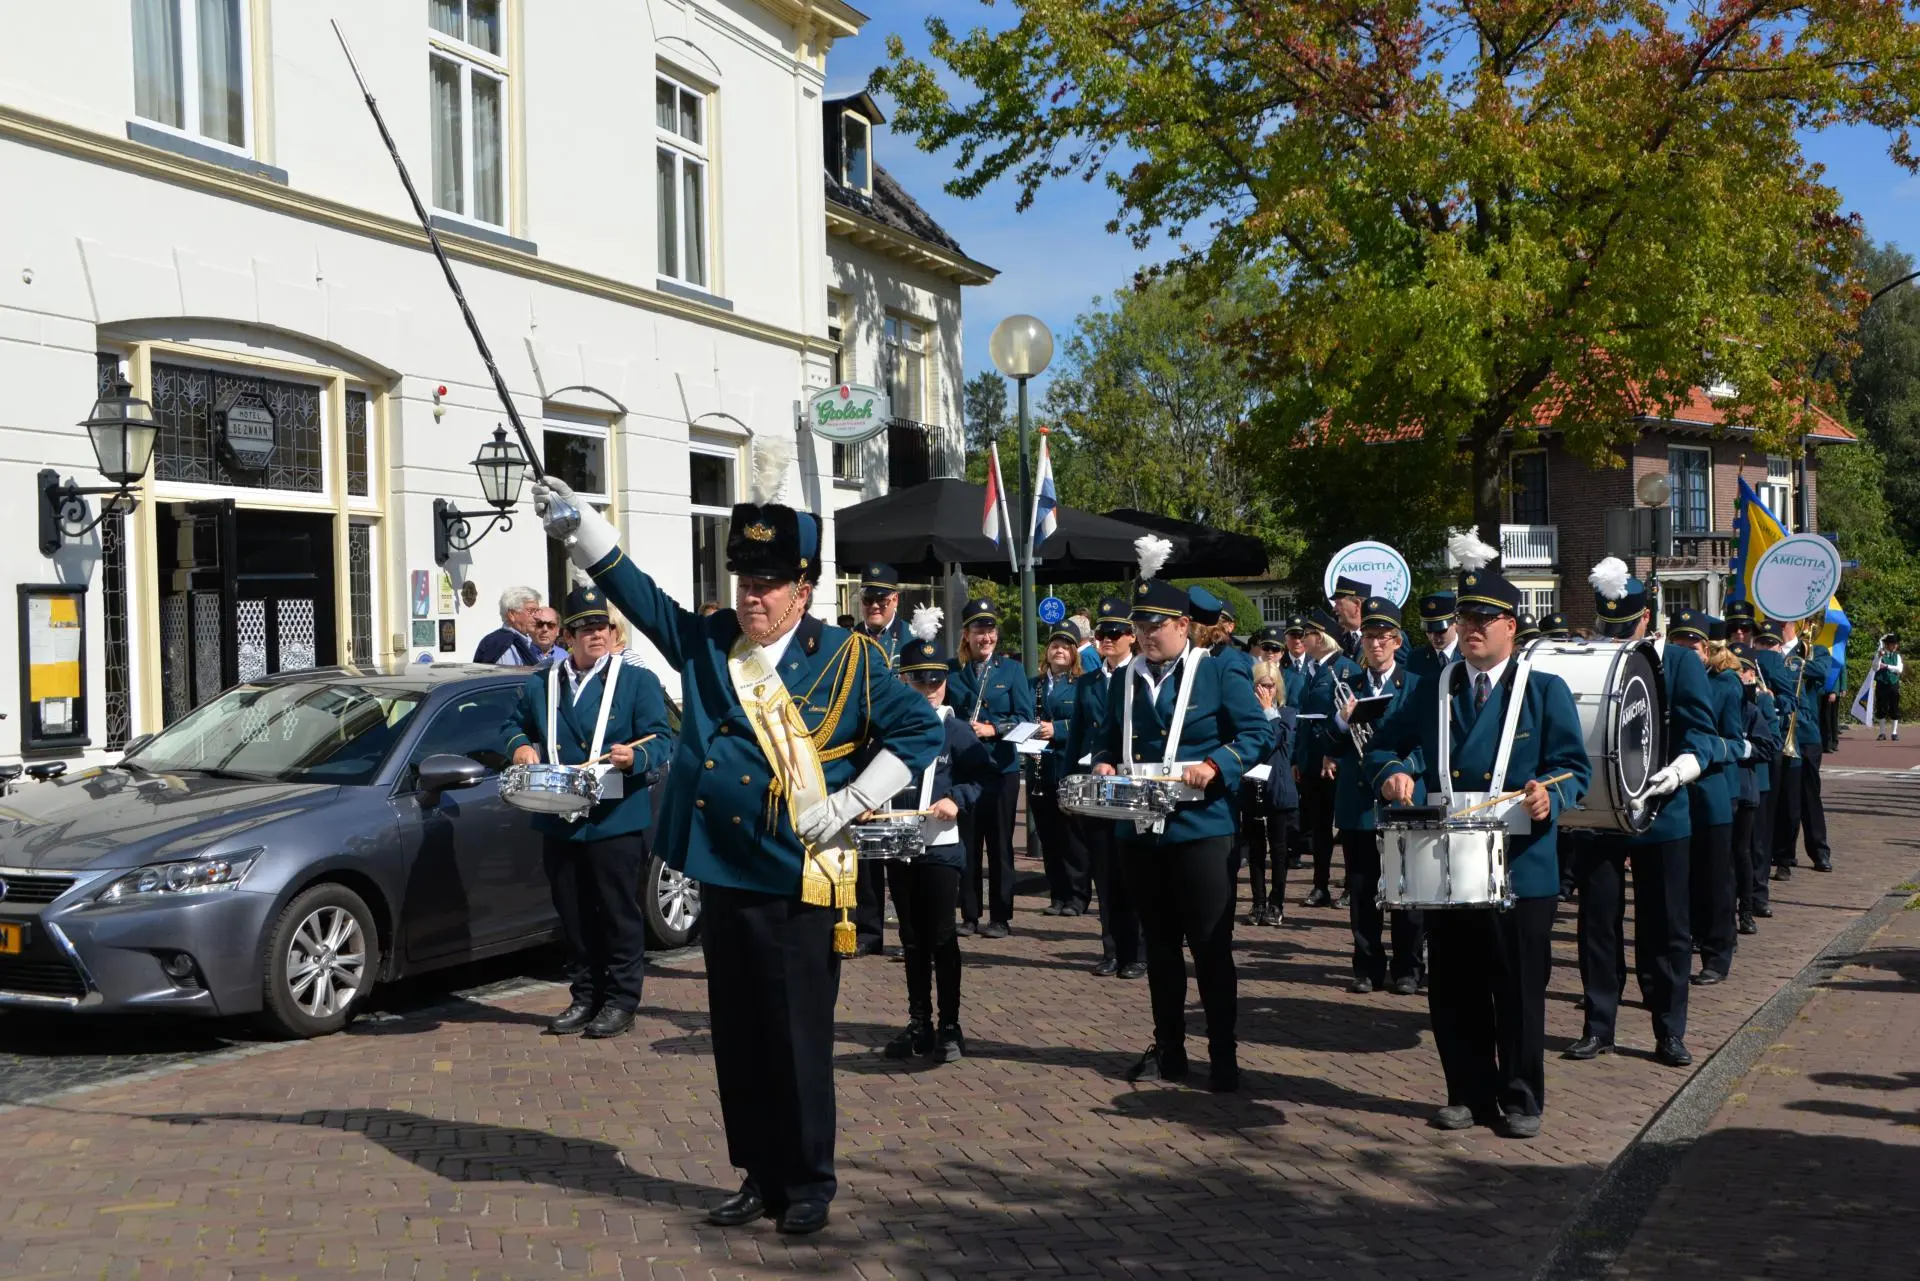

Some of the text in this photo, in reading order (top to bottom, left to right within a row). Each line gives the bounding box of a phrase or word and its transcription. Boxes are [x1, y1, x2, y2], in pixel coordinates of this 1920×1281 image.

[239, 411, 261, 421] HOTEL
[816, 399, 873, 425] Grolsch
[233, 423, 268, 437] DE ZWAAN
[1340, 562, 1395, 573] AMICITIA
[1770, 555, 1826, 569] AMICITIA
[1622, 697, 1646, 728] AMICITIA
